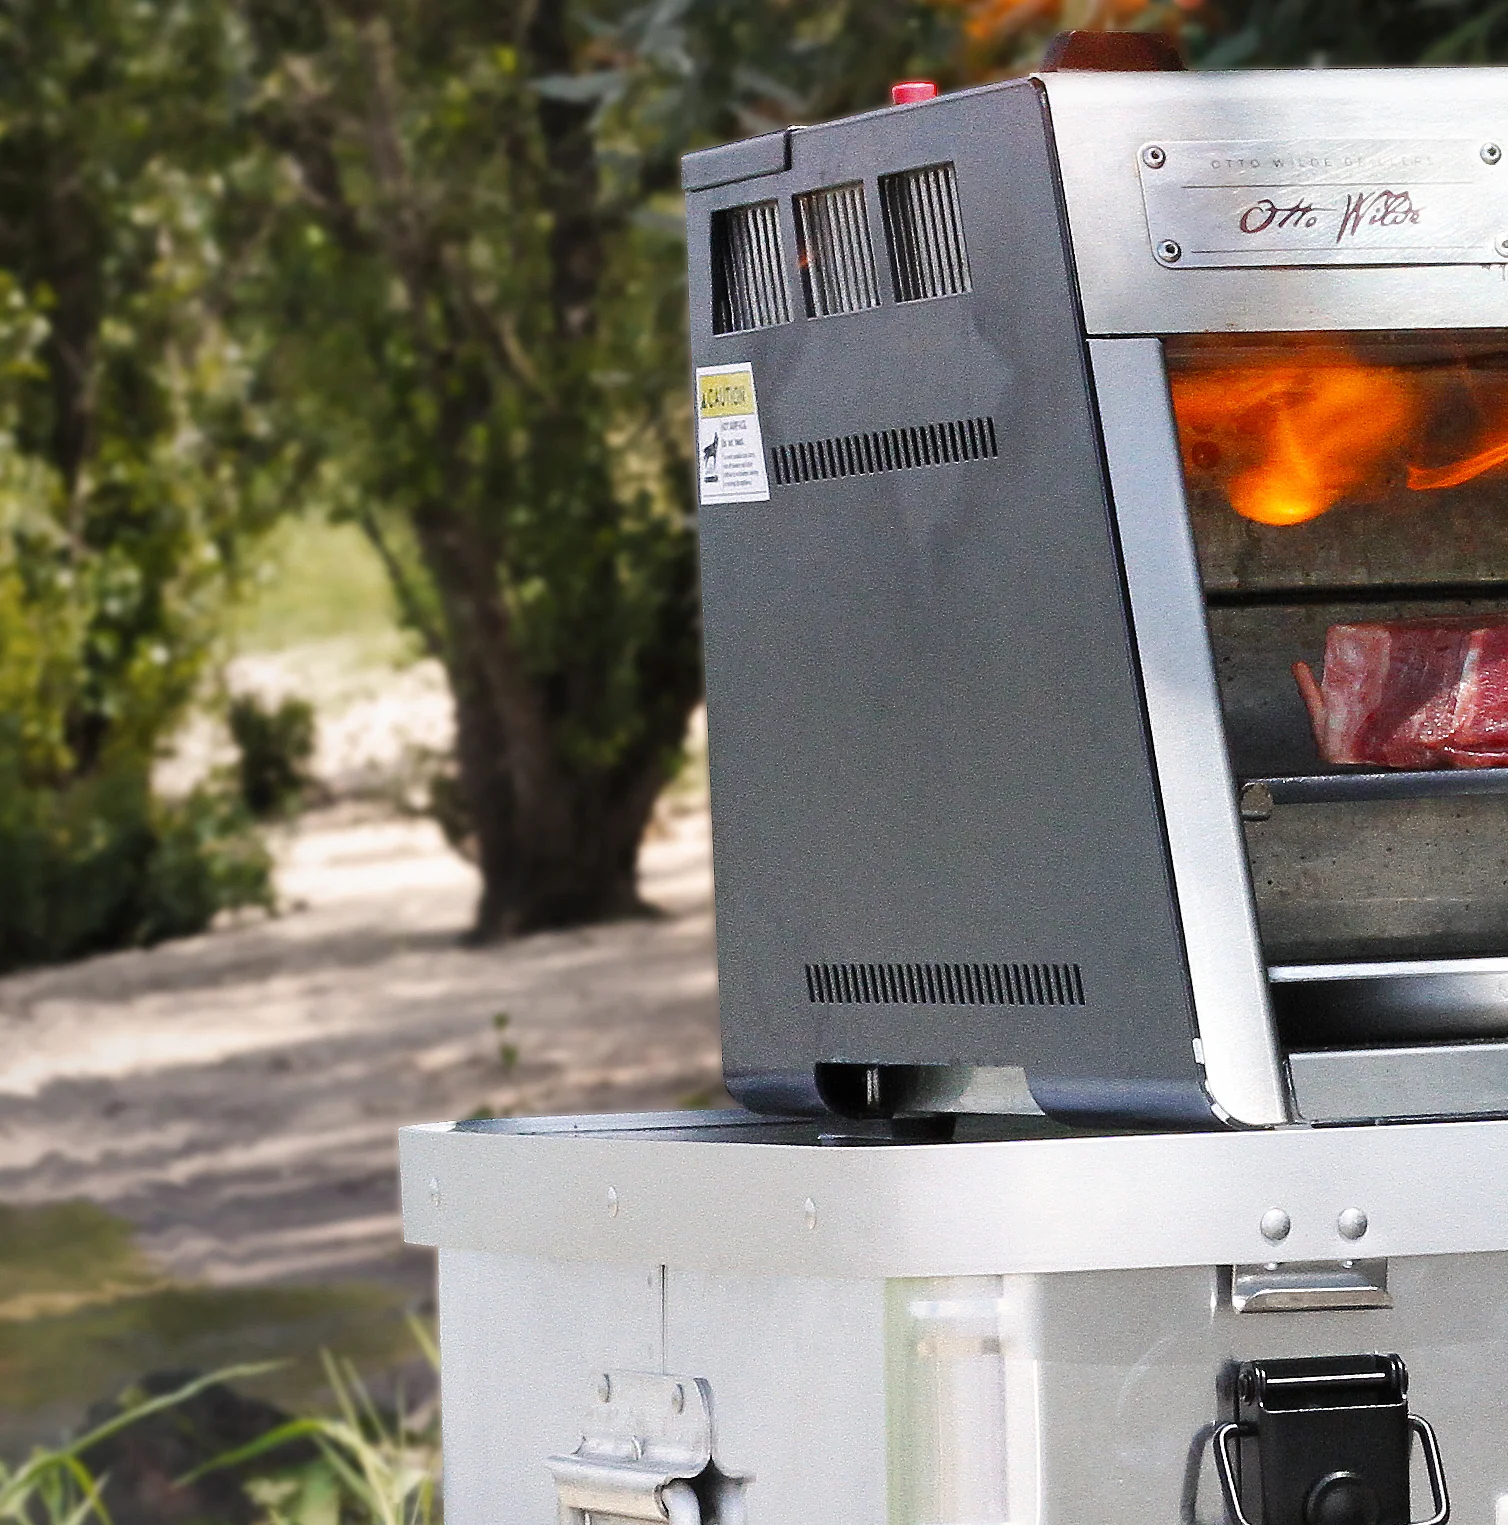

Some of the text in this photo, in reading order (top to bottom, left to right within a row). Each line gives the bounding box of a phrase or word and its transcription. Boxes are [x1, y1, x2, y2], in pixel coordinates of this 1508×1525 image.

[1211, 158, 1260, 170] OTTO
[1344, 156, 1435, 167] GRLLERS
[1239, 198, 1337, 235] Otto
